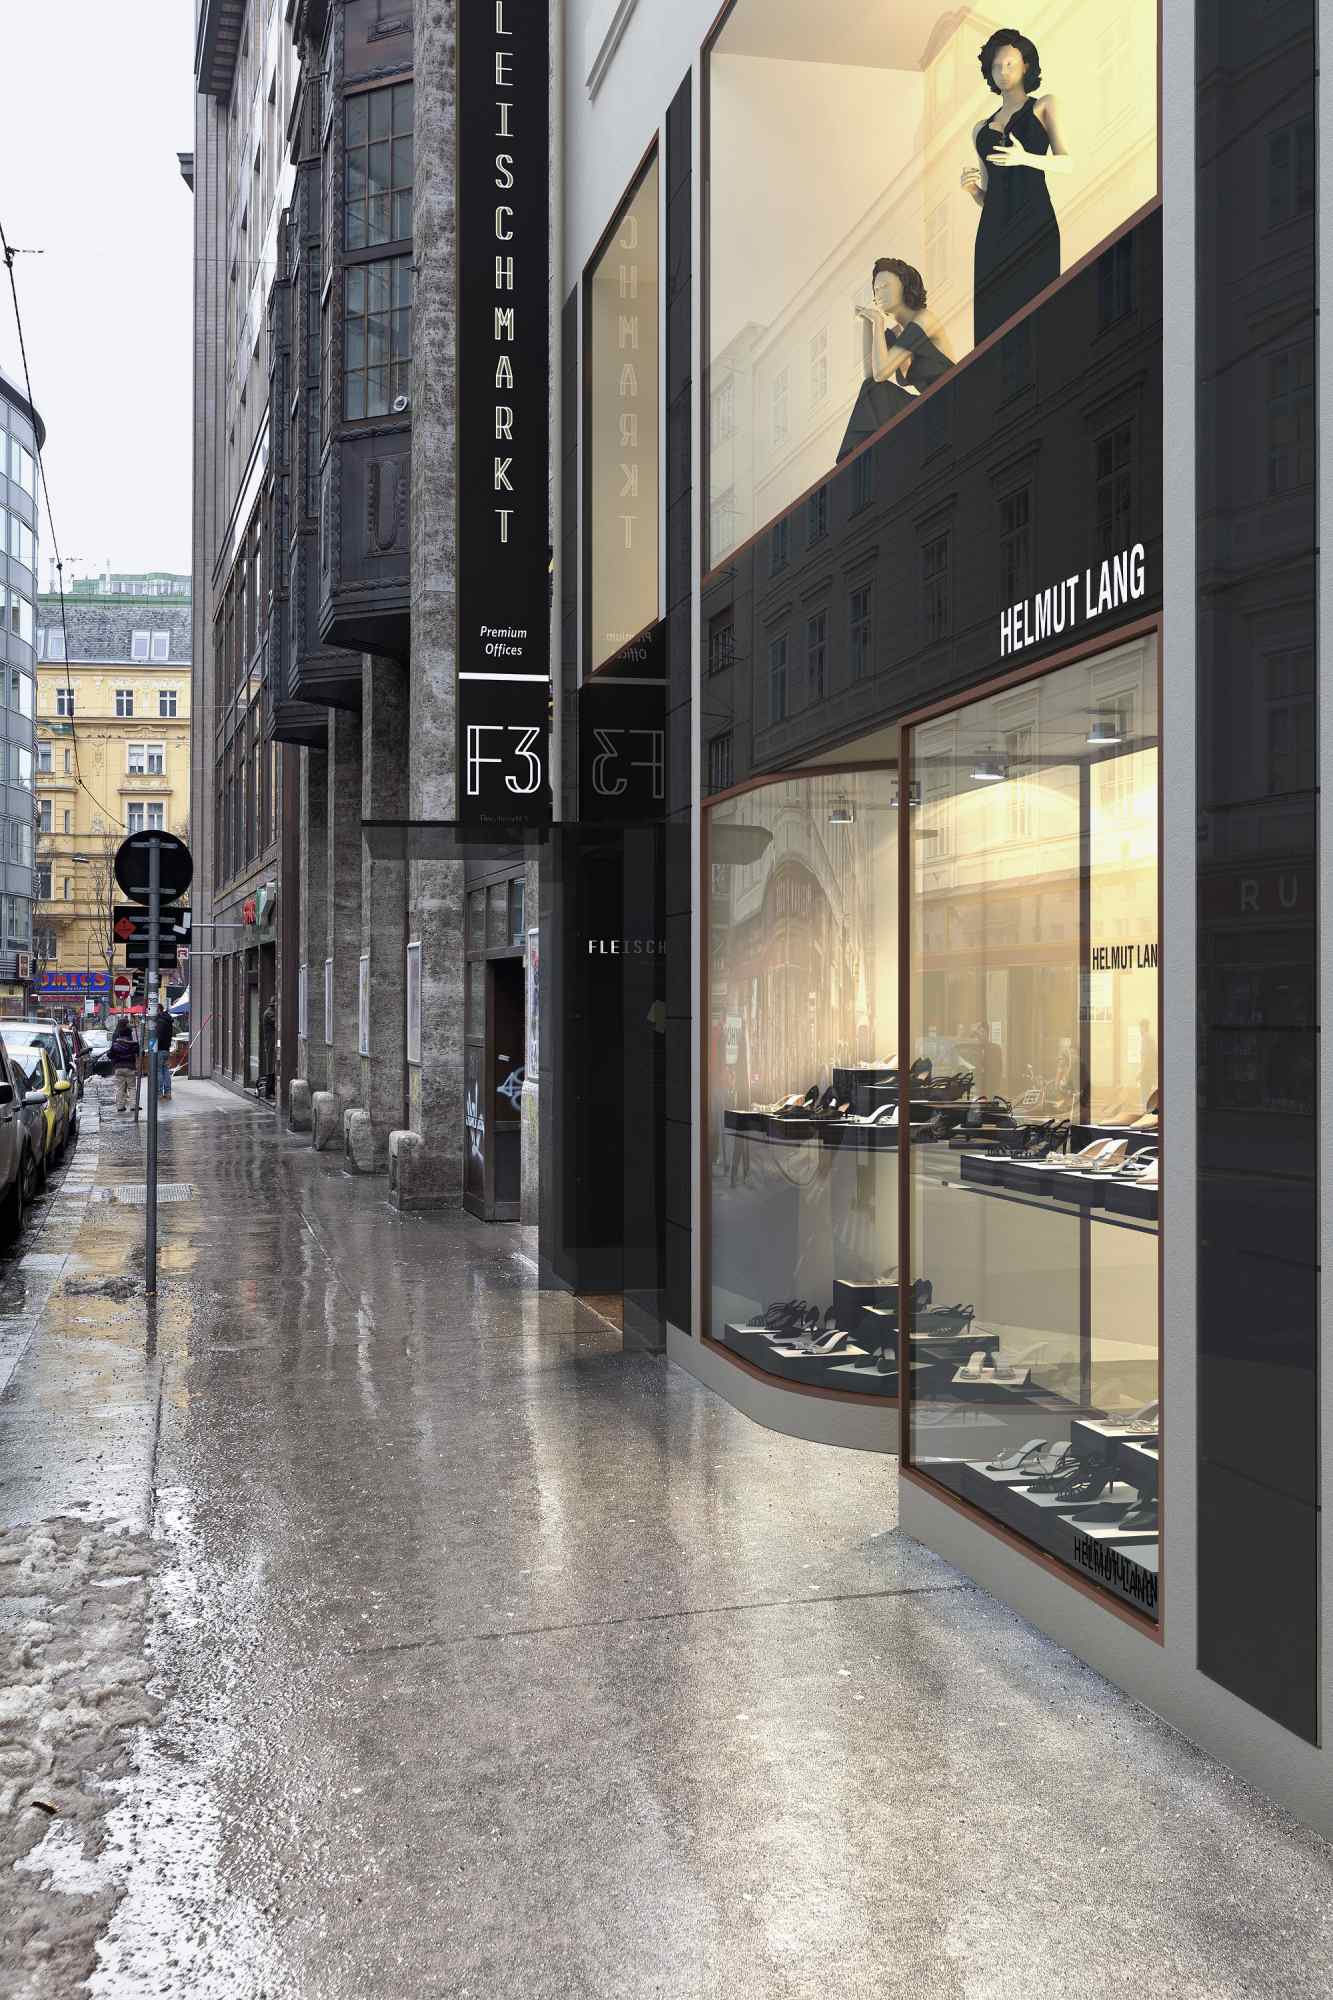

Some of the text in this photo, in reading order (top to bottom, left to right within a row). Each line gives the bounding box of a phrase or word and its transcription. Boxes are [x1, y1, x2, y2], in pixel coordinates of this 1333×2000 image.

[1000, 543, 1145, 657] HELMUT LANG
[479, 625, 527, 639] Premium
[485, 643, 523, 657] Offices
[466, 724, 541, 796] F3
[1092, 946, 1134, 970] HELMUT
